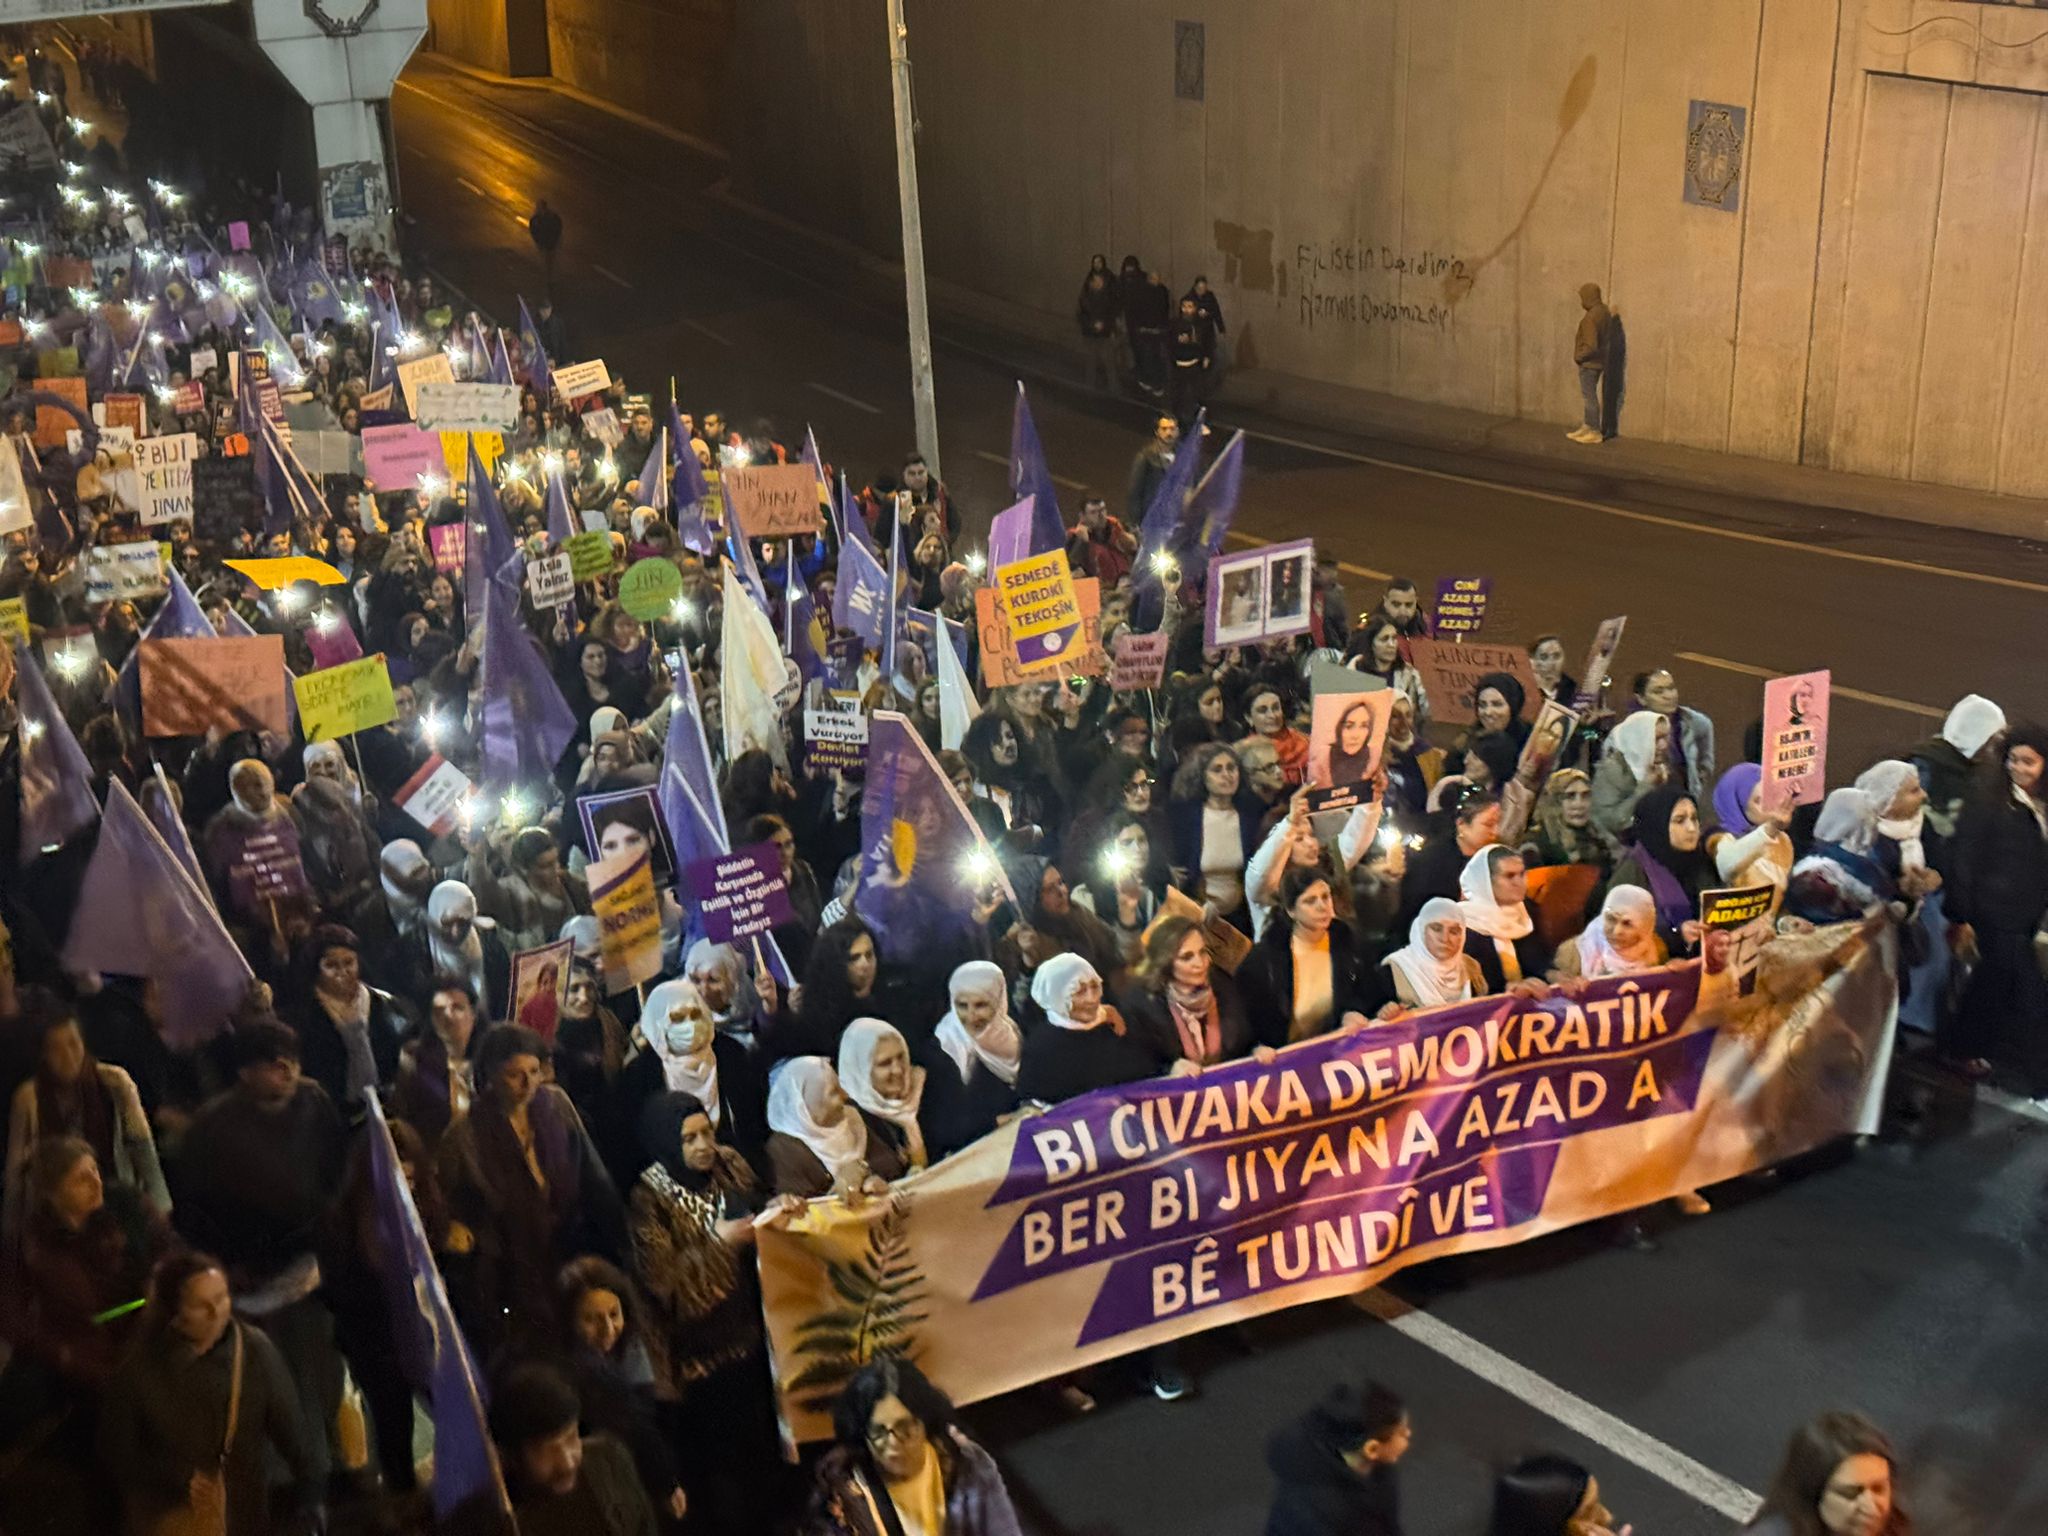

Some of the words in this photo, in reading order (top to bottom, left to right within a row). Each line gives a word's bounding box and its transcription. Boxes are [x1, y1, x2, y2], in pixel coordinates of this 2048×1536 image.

[1023, 1191, 1127, 1268] BER
[1150, 1175, 1198, 1232] BI
[1218, 1116, 1438, 1211] JIYANA
[1456, 1070, 1608, 1148] AZAD
[1625, 1060, 1662, 1110] A
[1032, 1127, 1095, 1183] BI
[1110, 1075, 1312, 1161] CIVAKA
[1320, 981, 1670, 1112] DEMOKRATÎK
[1152, 1236, 1220, 1317] BÊ
[1237, 1187, 1418, 1290] TUNDÎ
[1429, 1176, 1494, 1236] VE
